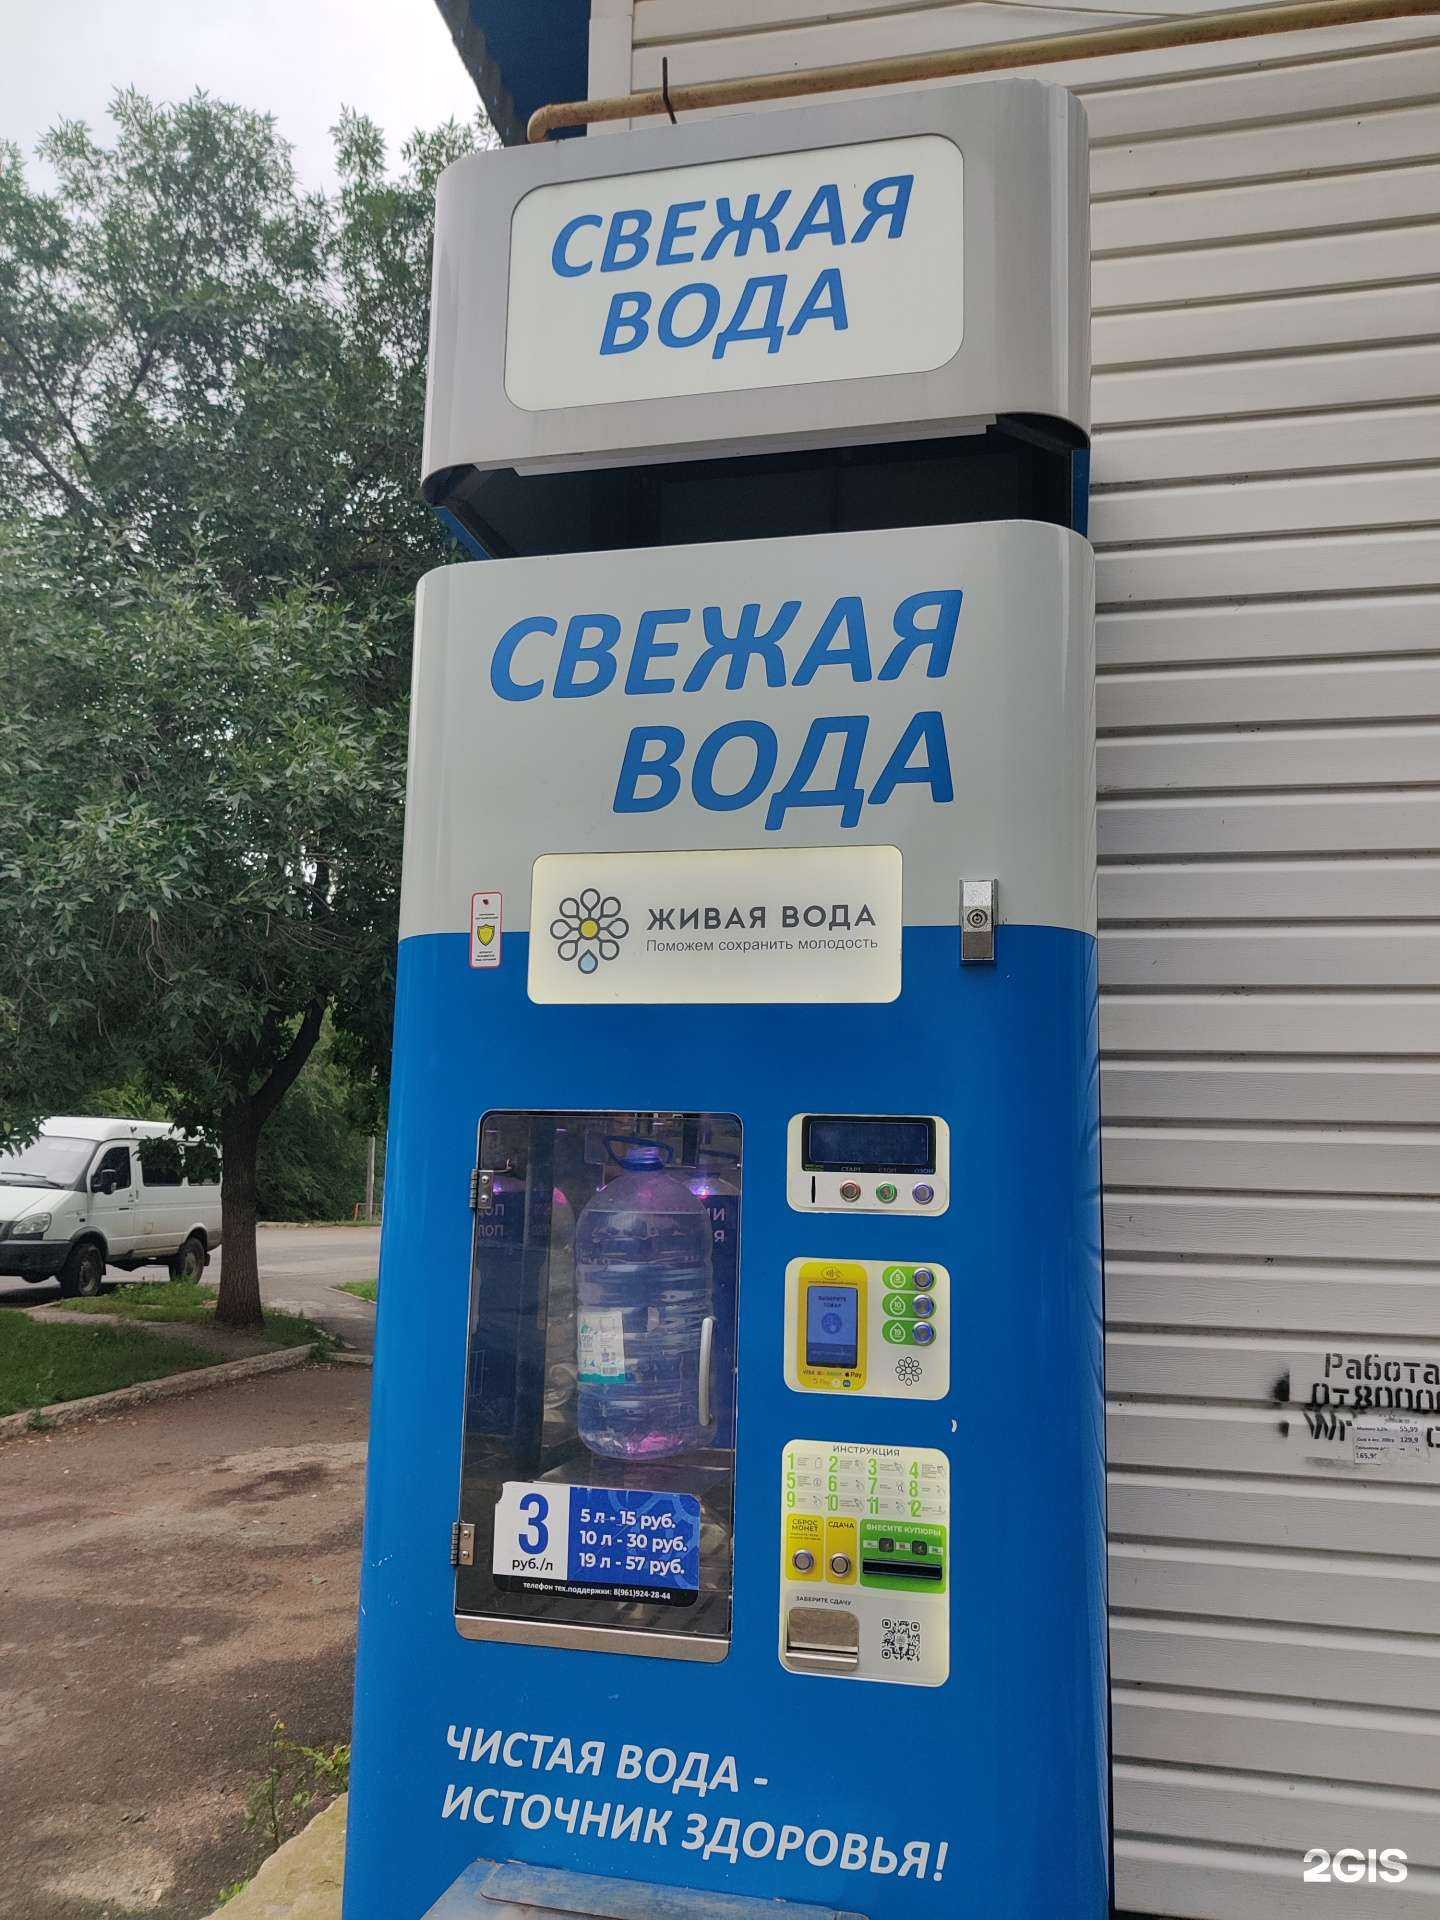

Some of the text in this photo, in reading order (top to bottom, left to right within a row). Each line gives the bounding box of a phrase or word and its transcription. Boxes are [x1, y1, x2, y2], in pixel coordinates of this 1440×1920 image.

[551, 174, 914, 278] СВЕЖАЯ
[599, 267, 849, 359] ВОДА
[490, 589, 963, 702] СВЕЖАЯ
[612, 711, 955, 831] ВОДА
[647, 903, 876, 931] ЖИВАЯ ВОДА
[646, 937, 878, 953] Поможем сохранить молодость
[833, 1444, 900, 1456] ИНСТРУКЦИЯ
[787, 1453, 794, 1469] 1
[828, 1455, 839, 1472] 2
[868, 1458, 877, 1475] 3
[909, 1461, 919, 1479] 4
[787, 1472, 795, 1489] 5
[828, 1475, 837, 1492] 6
[868, 1477, 878, 1494] 7
[909, 1480, 918, 1497] 8
[786, 1491, 795, 1508] 9
[826, 1494, 838, 1511] 10
[867, 1496, 879, 1514] 11
[518, 1493, 549, 1555] 3
[580, 1509, 590, 1523] 5
[594, 1512, 605, 1524] л
[620, 1510, 637, 1526] 15
[640, 1513, 676, 1529] руб.
[791, 1524, 818, 1532] МОНЕТ
[792, 1518, 818, 1526] СБРОС
[828, 1521, 854, 1529] СДАЧА
[866, 1523, 941, 1536] ВНЕСИТЕ КУПЮРЫ
[580, 1530, 597, 1545] 10
[600, 1534, 612, 1547] л
[627, 1533, 648, 1549] 30
[652, 1535, 688, 1553] руб.
[512, 1557, 554, 1572] руб./л
[579, 1552, 596, 1568] 19
[600, 1556, 612, 1569] л
[626, 1556, 645, 1571] 57
[650, 1558, 685, 1576] руб.
[523, 1581, 671, 1600] телефон тех.поддержки: 8(961)924-28-44
[796, 1595, 852, 1606] ЗАБЕРИТЕ СДАЧУ
[446, 1725, 768, 1797] ЧИСТАЯ ВОДА -
[441, 1784, 949, 1882] ИСТОЧНИК ЗДОРОВЬЯ!
